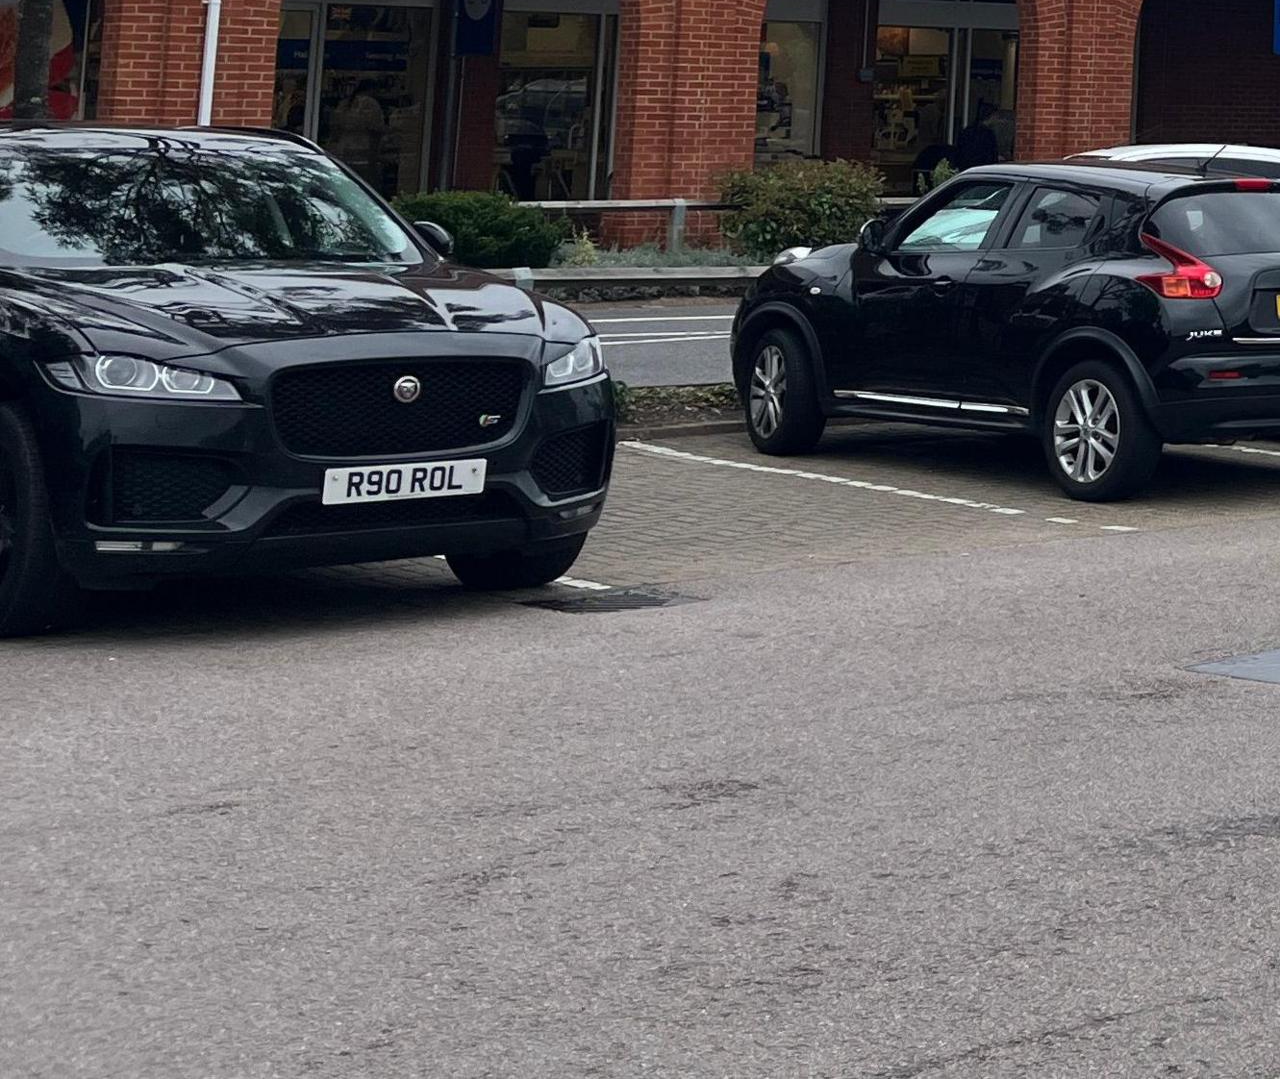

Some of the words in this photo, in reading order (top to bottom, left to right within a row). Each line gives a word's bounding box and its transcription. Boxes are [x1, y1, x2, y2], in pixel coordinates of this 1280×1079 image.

[1186, 329, 1223, 341] JUKE
[346, 469, 403, 498] R90
[410, 465, 463, 493] ROL
